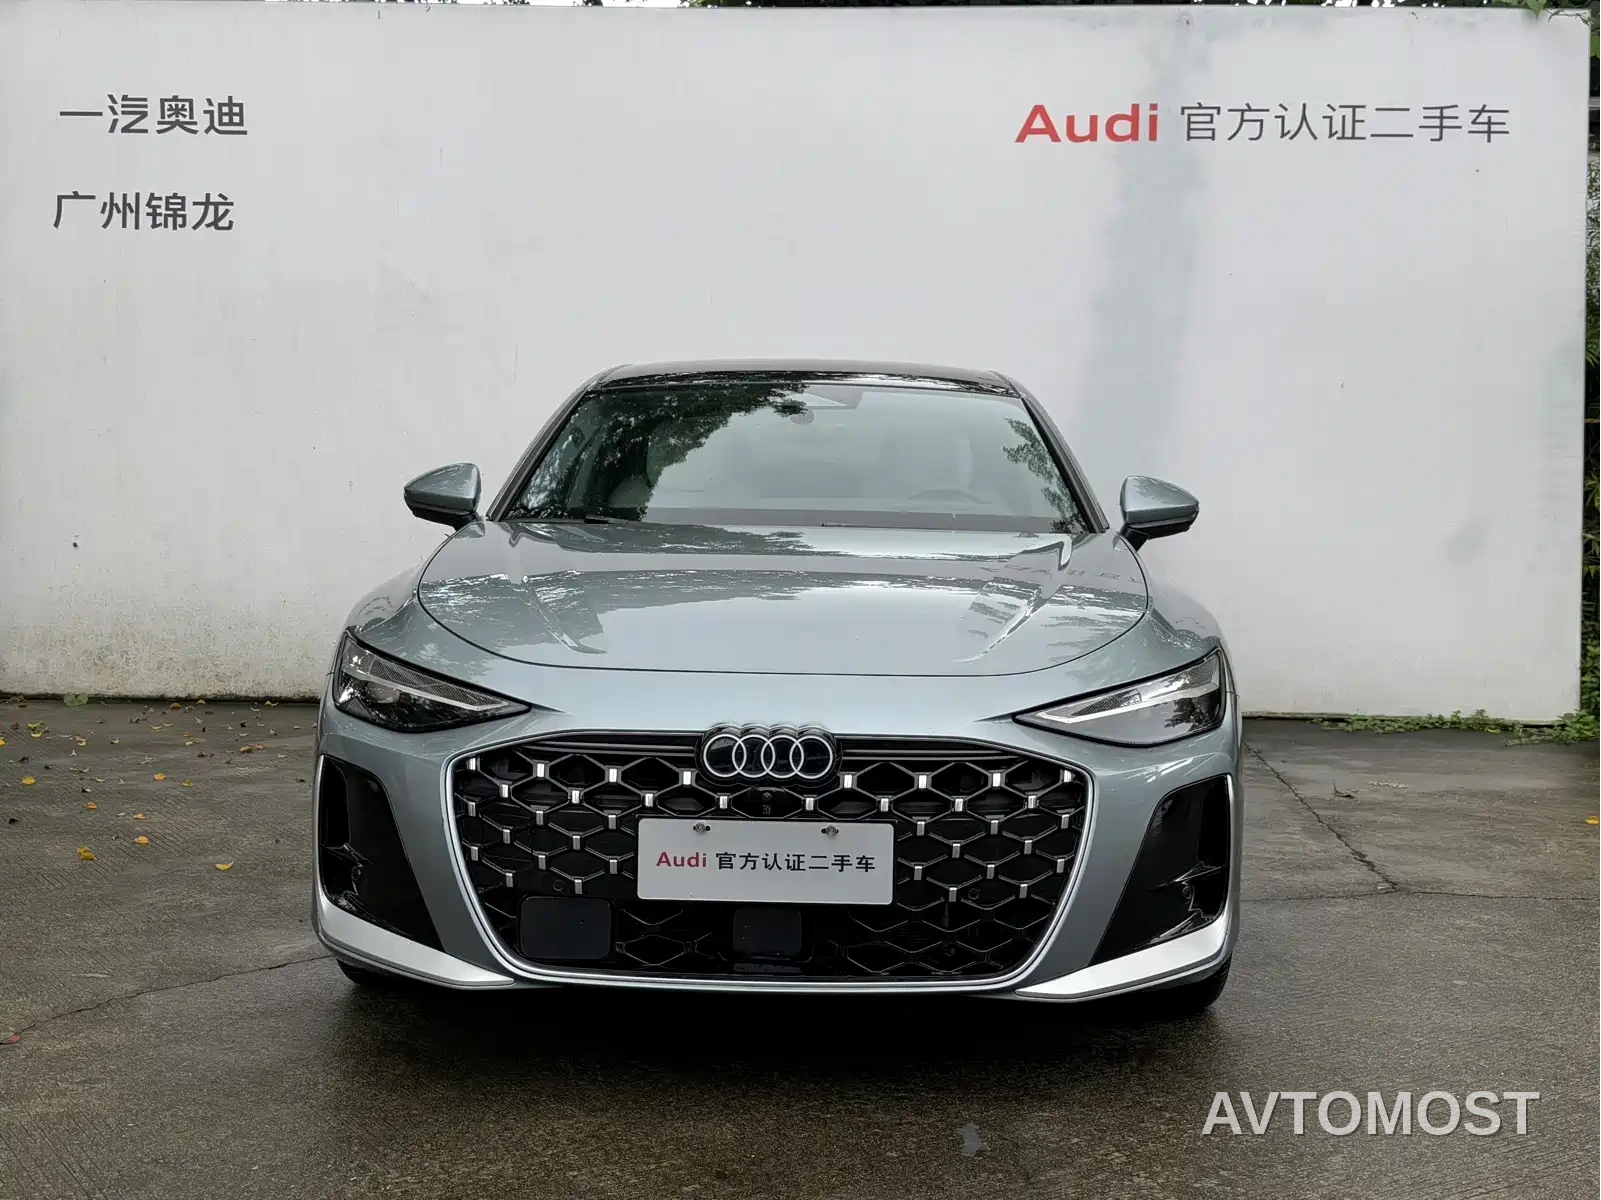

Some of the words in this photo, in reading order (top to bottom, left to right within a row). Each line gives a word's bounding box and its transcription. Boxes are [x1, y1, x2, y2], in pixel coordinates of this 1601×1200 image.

[60, 94, 248, 136] 一汽奥迪
[1015, 103, 1159, 143] Audi
[1180, 102, 1510, 144] 官方认证二手车
[53, 191, 235, 231] 广州锦龙
[656, 852, 707, 868] Audi
[716, 852, 876, 873] 官方认证二手车
